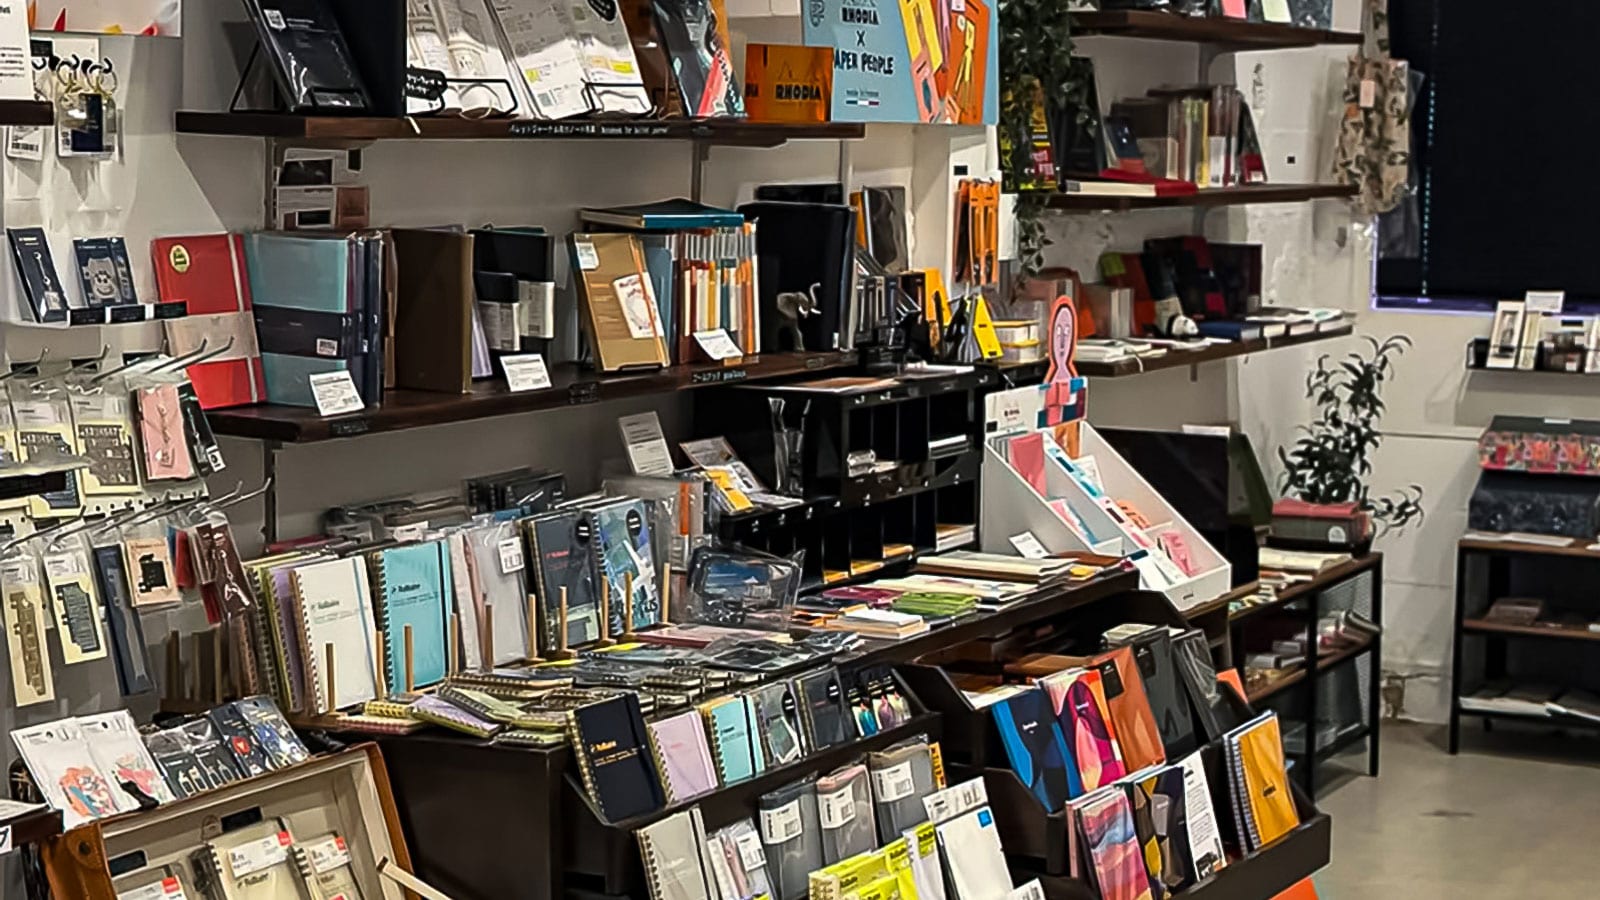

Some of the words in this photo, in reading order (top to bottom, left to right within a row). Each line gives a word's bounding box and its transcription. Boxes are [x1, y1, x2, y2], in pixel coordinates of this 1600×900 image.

[842, 7, 879, 25] RHODIA
[856, 30, 865, 47] X
[861, 53, 894, 75] PEOPLE
[775, 84, 822, 100] RHODIA
